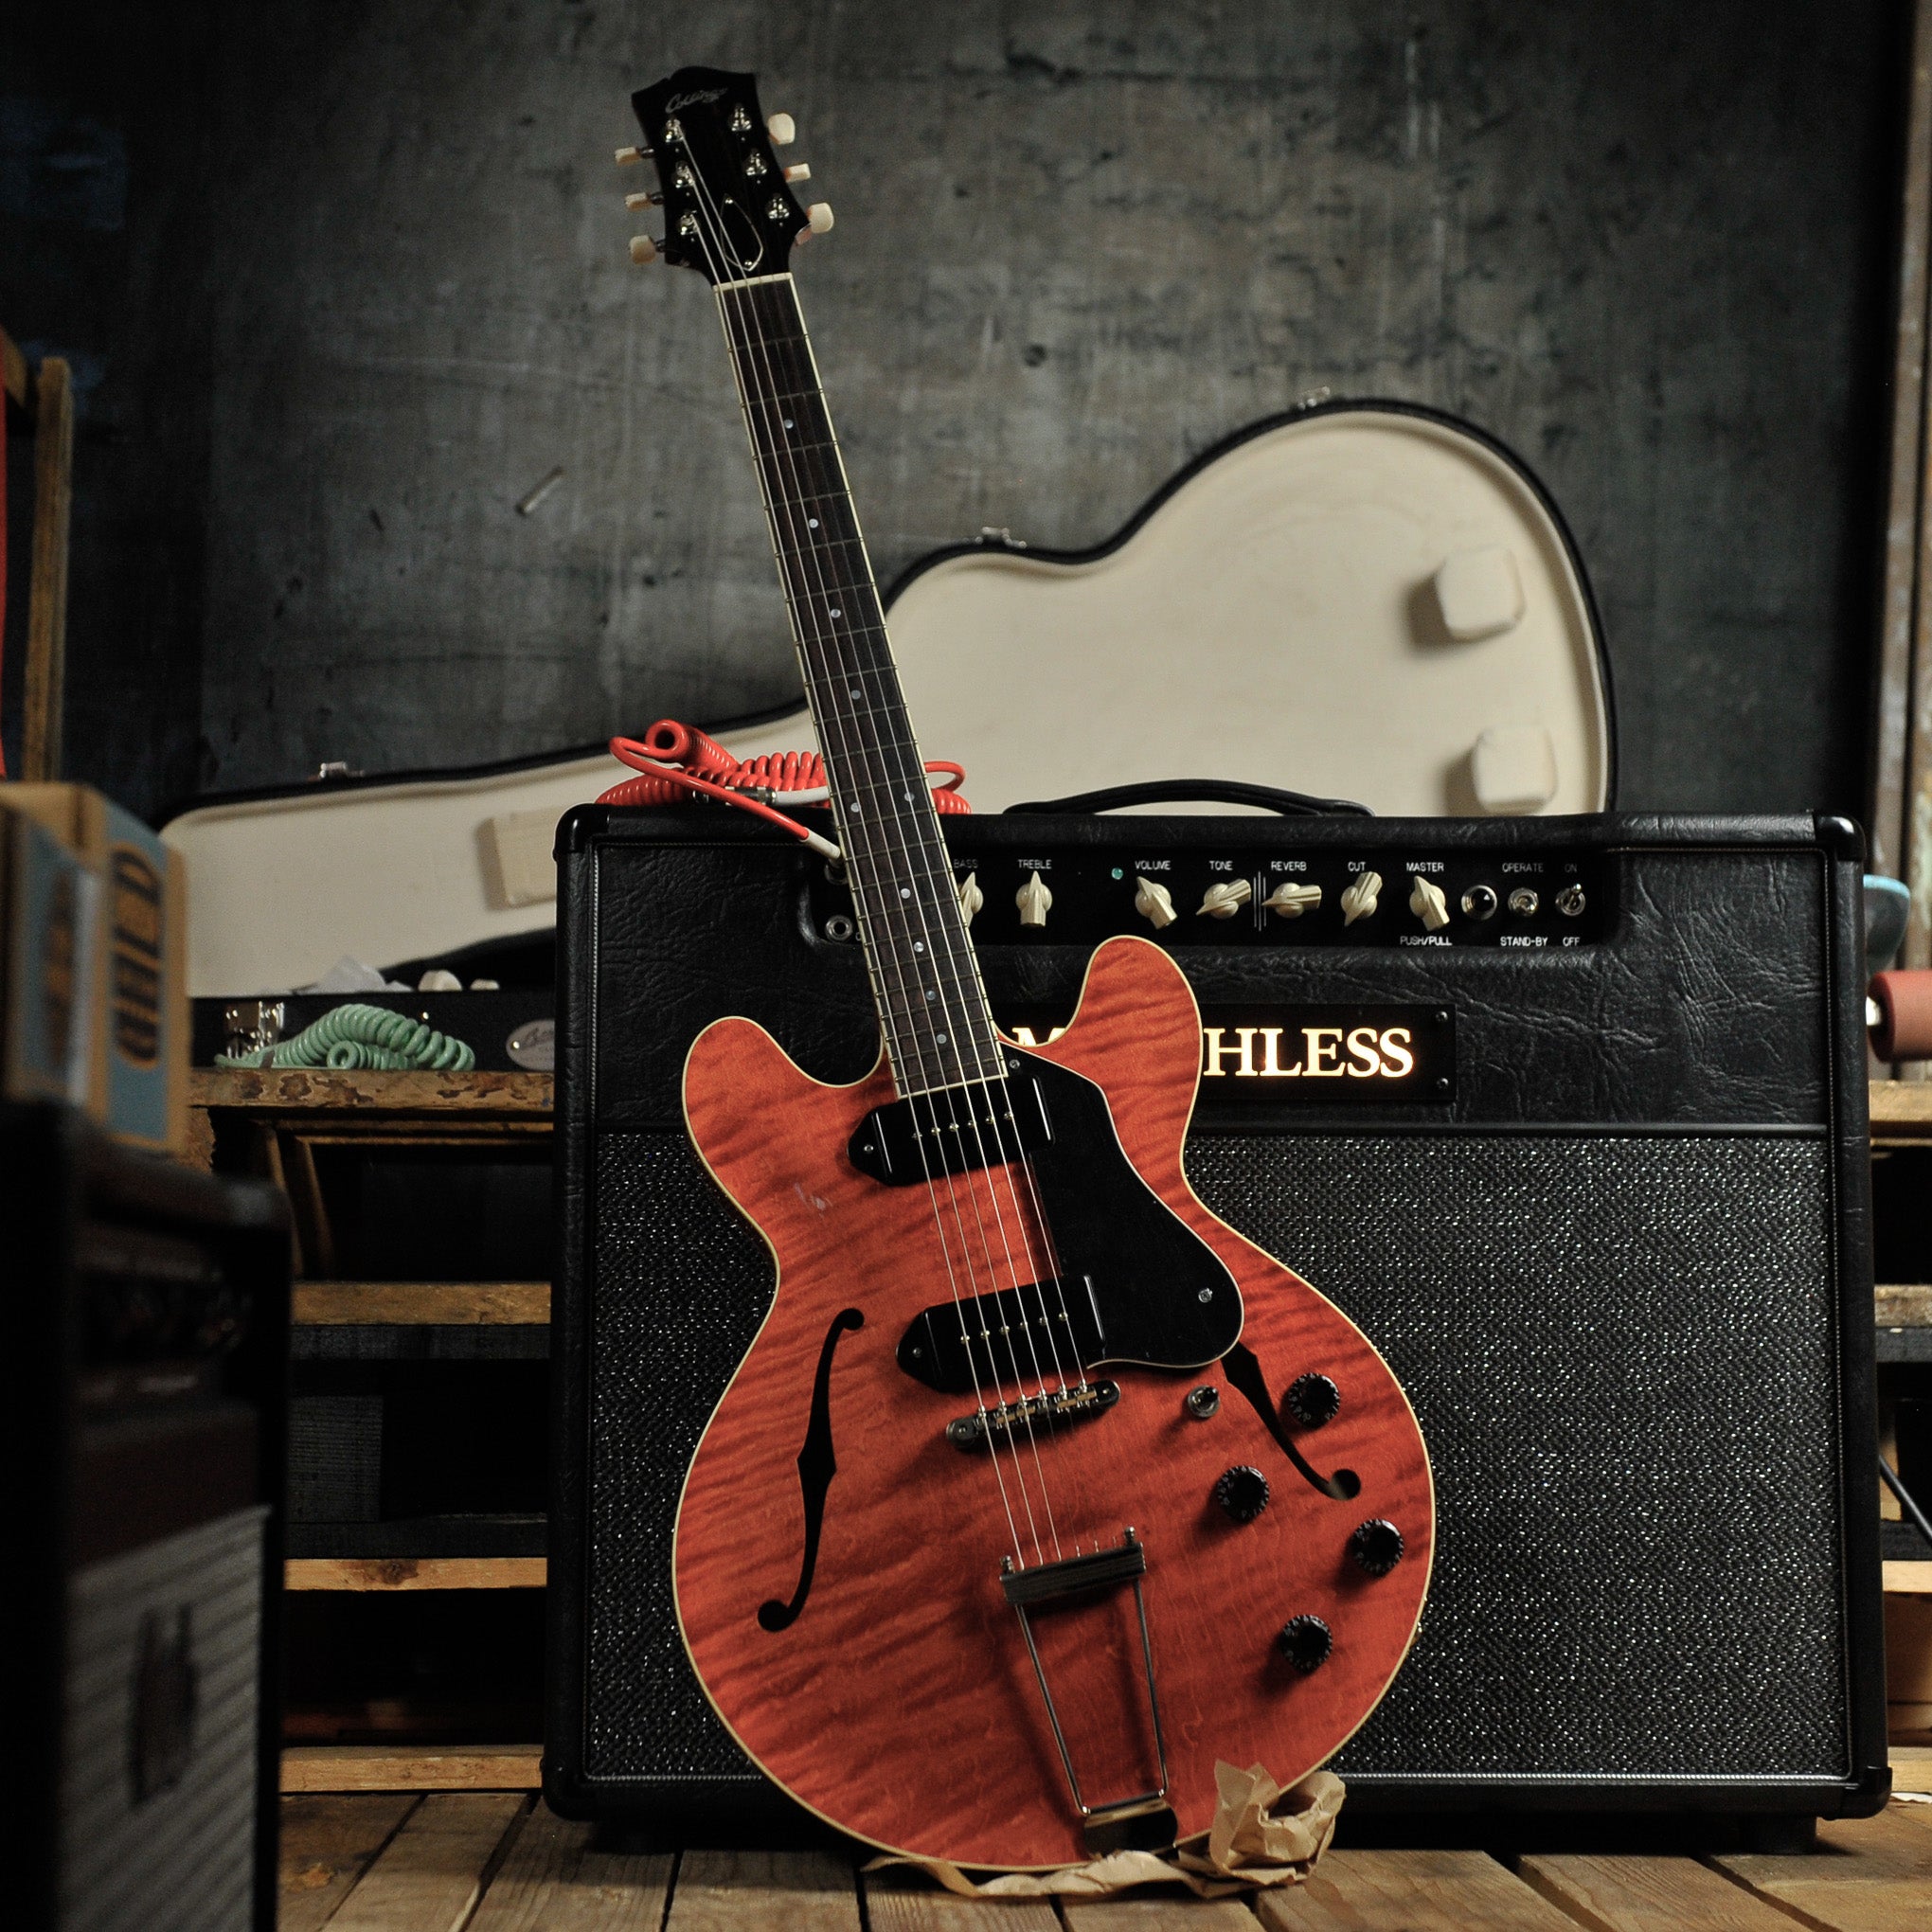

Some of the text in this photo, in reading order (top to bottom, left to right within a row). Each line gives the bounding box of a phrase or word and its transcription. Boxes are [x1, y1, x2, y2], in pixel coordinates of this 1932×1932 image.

[953, 859, 978, 868] BASS
[1018, 859, 1052, 869] TREBLE
[1135, 860, 1172, 870] VOLUME
[1208, 860, 1234, 871] TONE
[1271, 861, 1307, 871] REVERB
[1348, 861, 1366, 872] CUT
[1405, 862, 1444, 872] MASTER
[1502, 862, 1545, 872] OPERATE
[1565, 863, 1578, 872] ON
[1400, 936, 1453, 946] PUSH/PULL
[1499, 936, 1548, 947] STAND-BY
[1562, 936, 1581, 947] OFF
